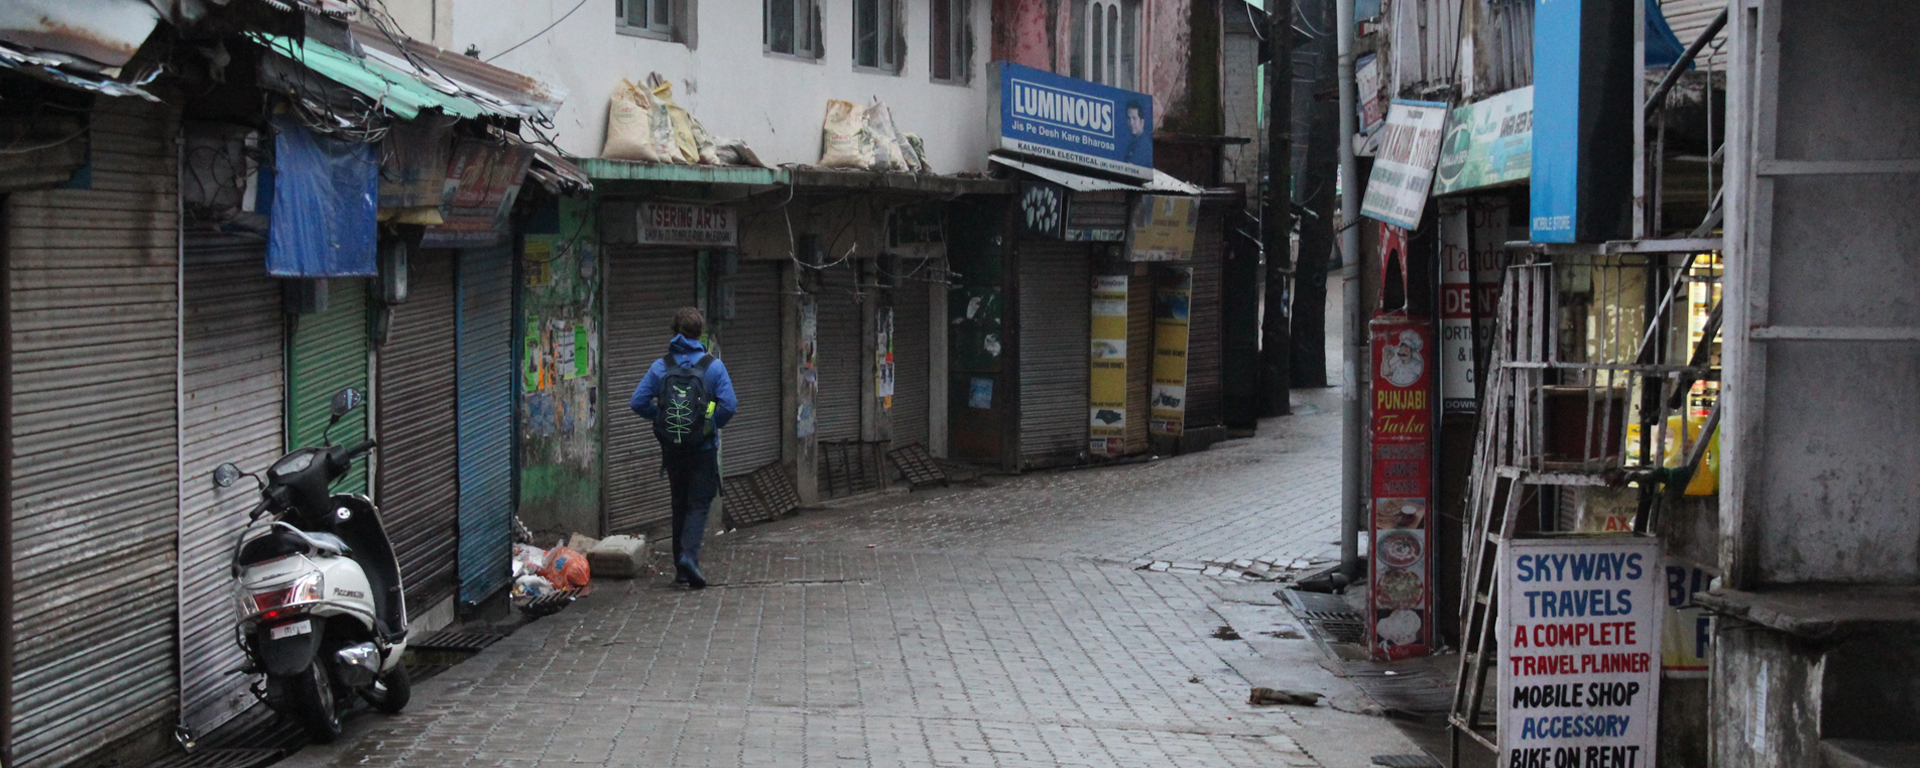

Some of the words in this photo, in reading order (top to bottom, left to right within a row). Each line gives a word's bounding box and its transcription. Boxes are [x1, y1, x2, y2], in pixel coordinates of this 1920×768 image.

[1014, 84, 1112, 132] LUMINOUS
[1011, 120, 1025, 132] Jis
[1026, 123, 1038, 135] Pe
[1038, 126, 1060, 140] Desh
[1061, 131, 1081, 144] Kare
[1082, 135, 1115, 151] Bharosa
[1017, 142, 1056, 157] KALMOTRA
[1057, 150, 1099, 166] ELECTRICAL
[647, 204, 693, 228] TSERING
[696, 207, 727, 229] ARTS
[1533, 218, 1552, 231] MOBILE
[1553, 216, 1571, 230] STORE
[1092, 361, 1109, 369] CHANGE
[1457, 346, 1467, 361] &
[1377, 390, 1426, 410] PUNJABI
[1376, 414, 1425, 434] Tarka
[1517, 552, 1643, 582] SKYWAYS
[1524, 589, 1632, 618] TRAVELS
[1514, 625, 1528, 648] A
[1533, 621, 1636, 647] COMPLETE
[1510, 655, 1579, 676] TRAVEL
[1581, 653, 1650, 674] PLANNER
[1513, 683, 1583, 709] MOBILE
[1586, 681, 1640, 707] SHOP
[1521, 714, 1630, 740] ACCESSORY
[1509, 747, 1551, 768] BIKE
[1554, 747, 1581, 768] ON
[1585, 745, 1640, 768] RENT
